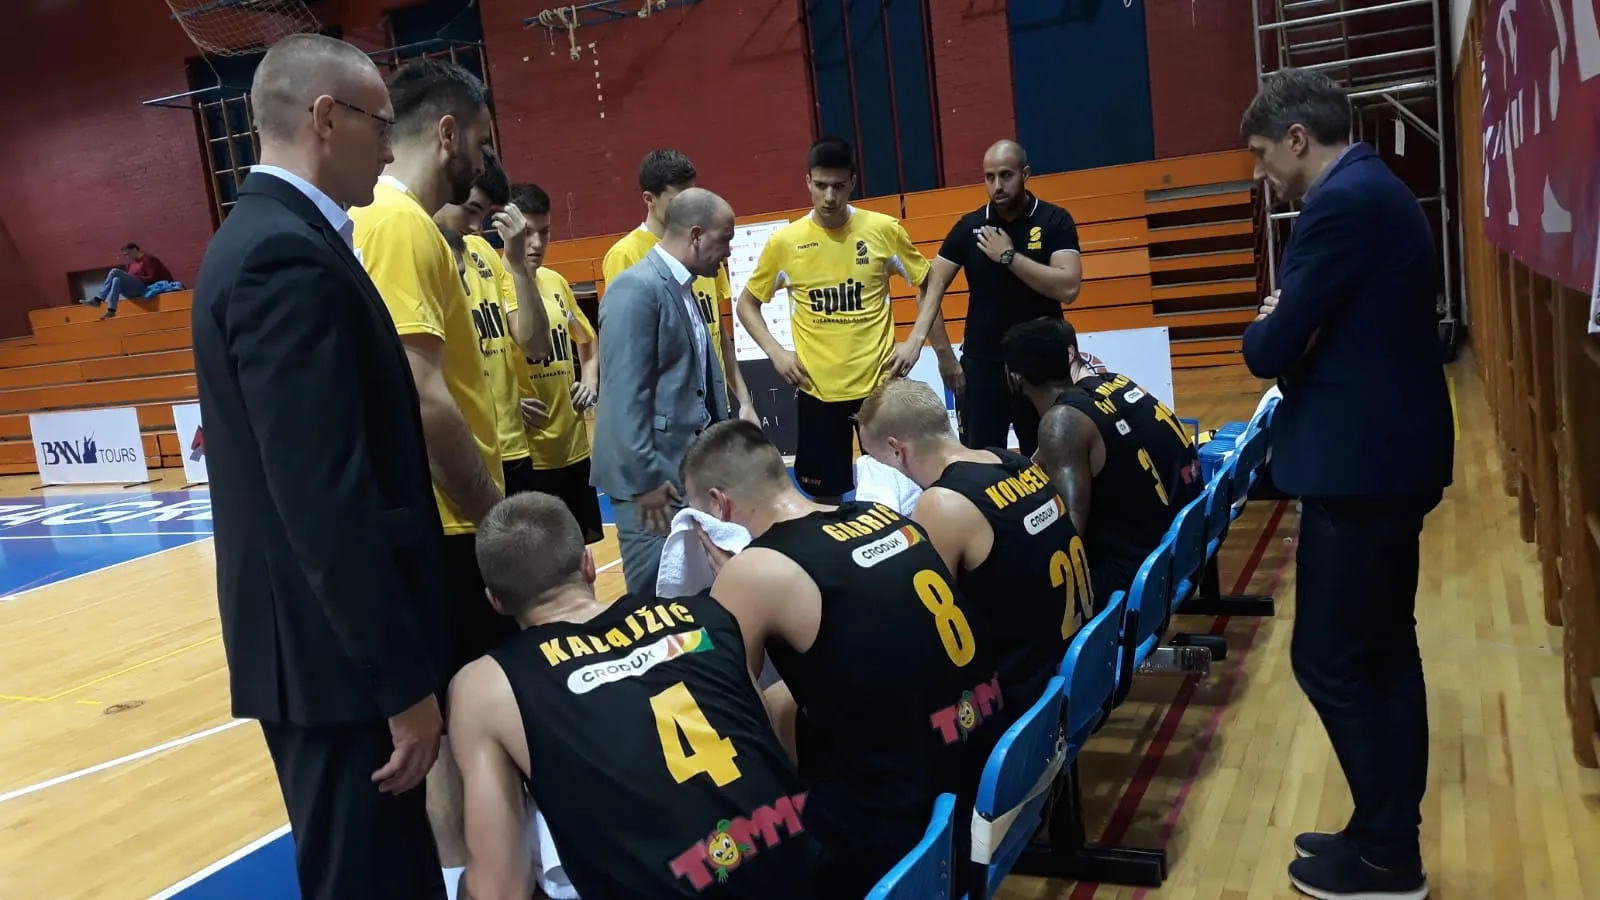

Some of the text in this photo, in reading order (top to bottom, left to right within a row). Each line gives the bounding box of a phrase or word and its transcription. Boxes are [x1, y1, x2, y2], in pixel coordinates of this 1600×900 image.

[809, 278, 866, 315] split
[98, 447, 137, 464] TOURS
[1030, 505, 1055, 528] CRODUX
[862, 538, 902, 559] CRODUX
[1050, 536, 1094, 640] 20
[913, 569, 976, 667] 8
[581, 651, 656, 684] CRODUX
[650, 681, 742, 787] 4
